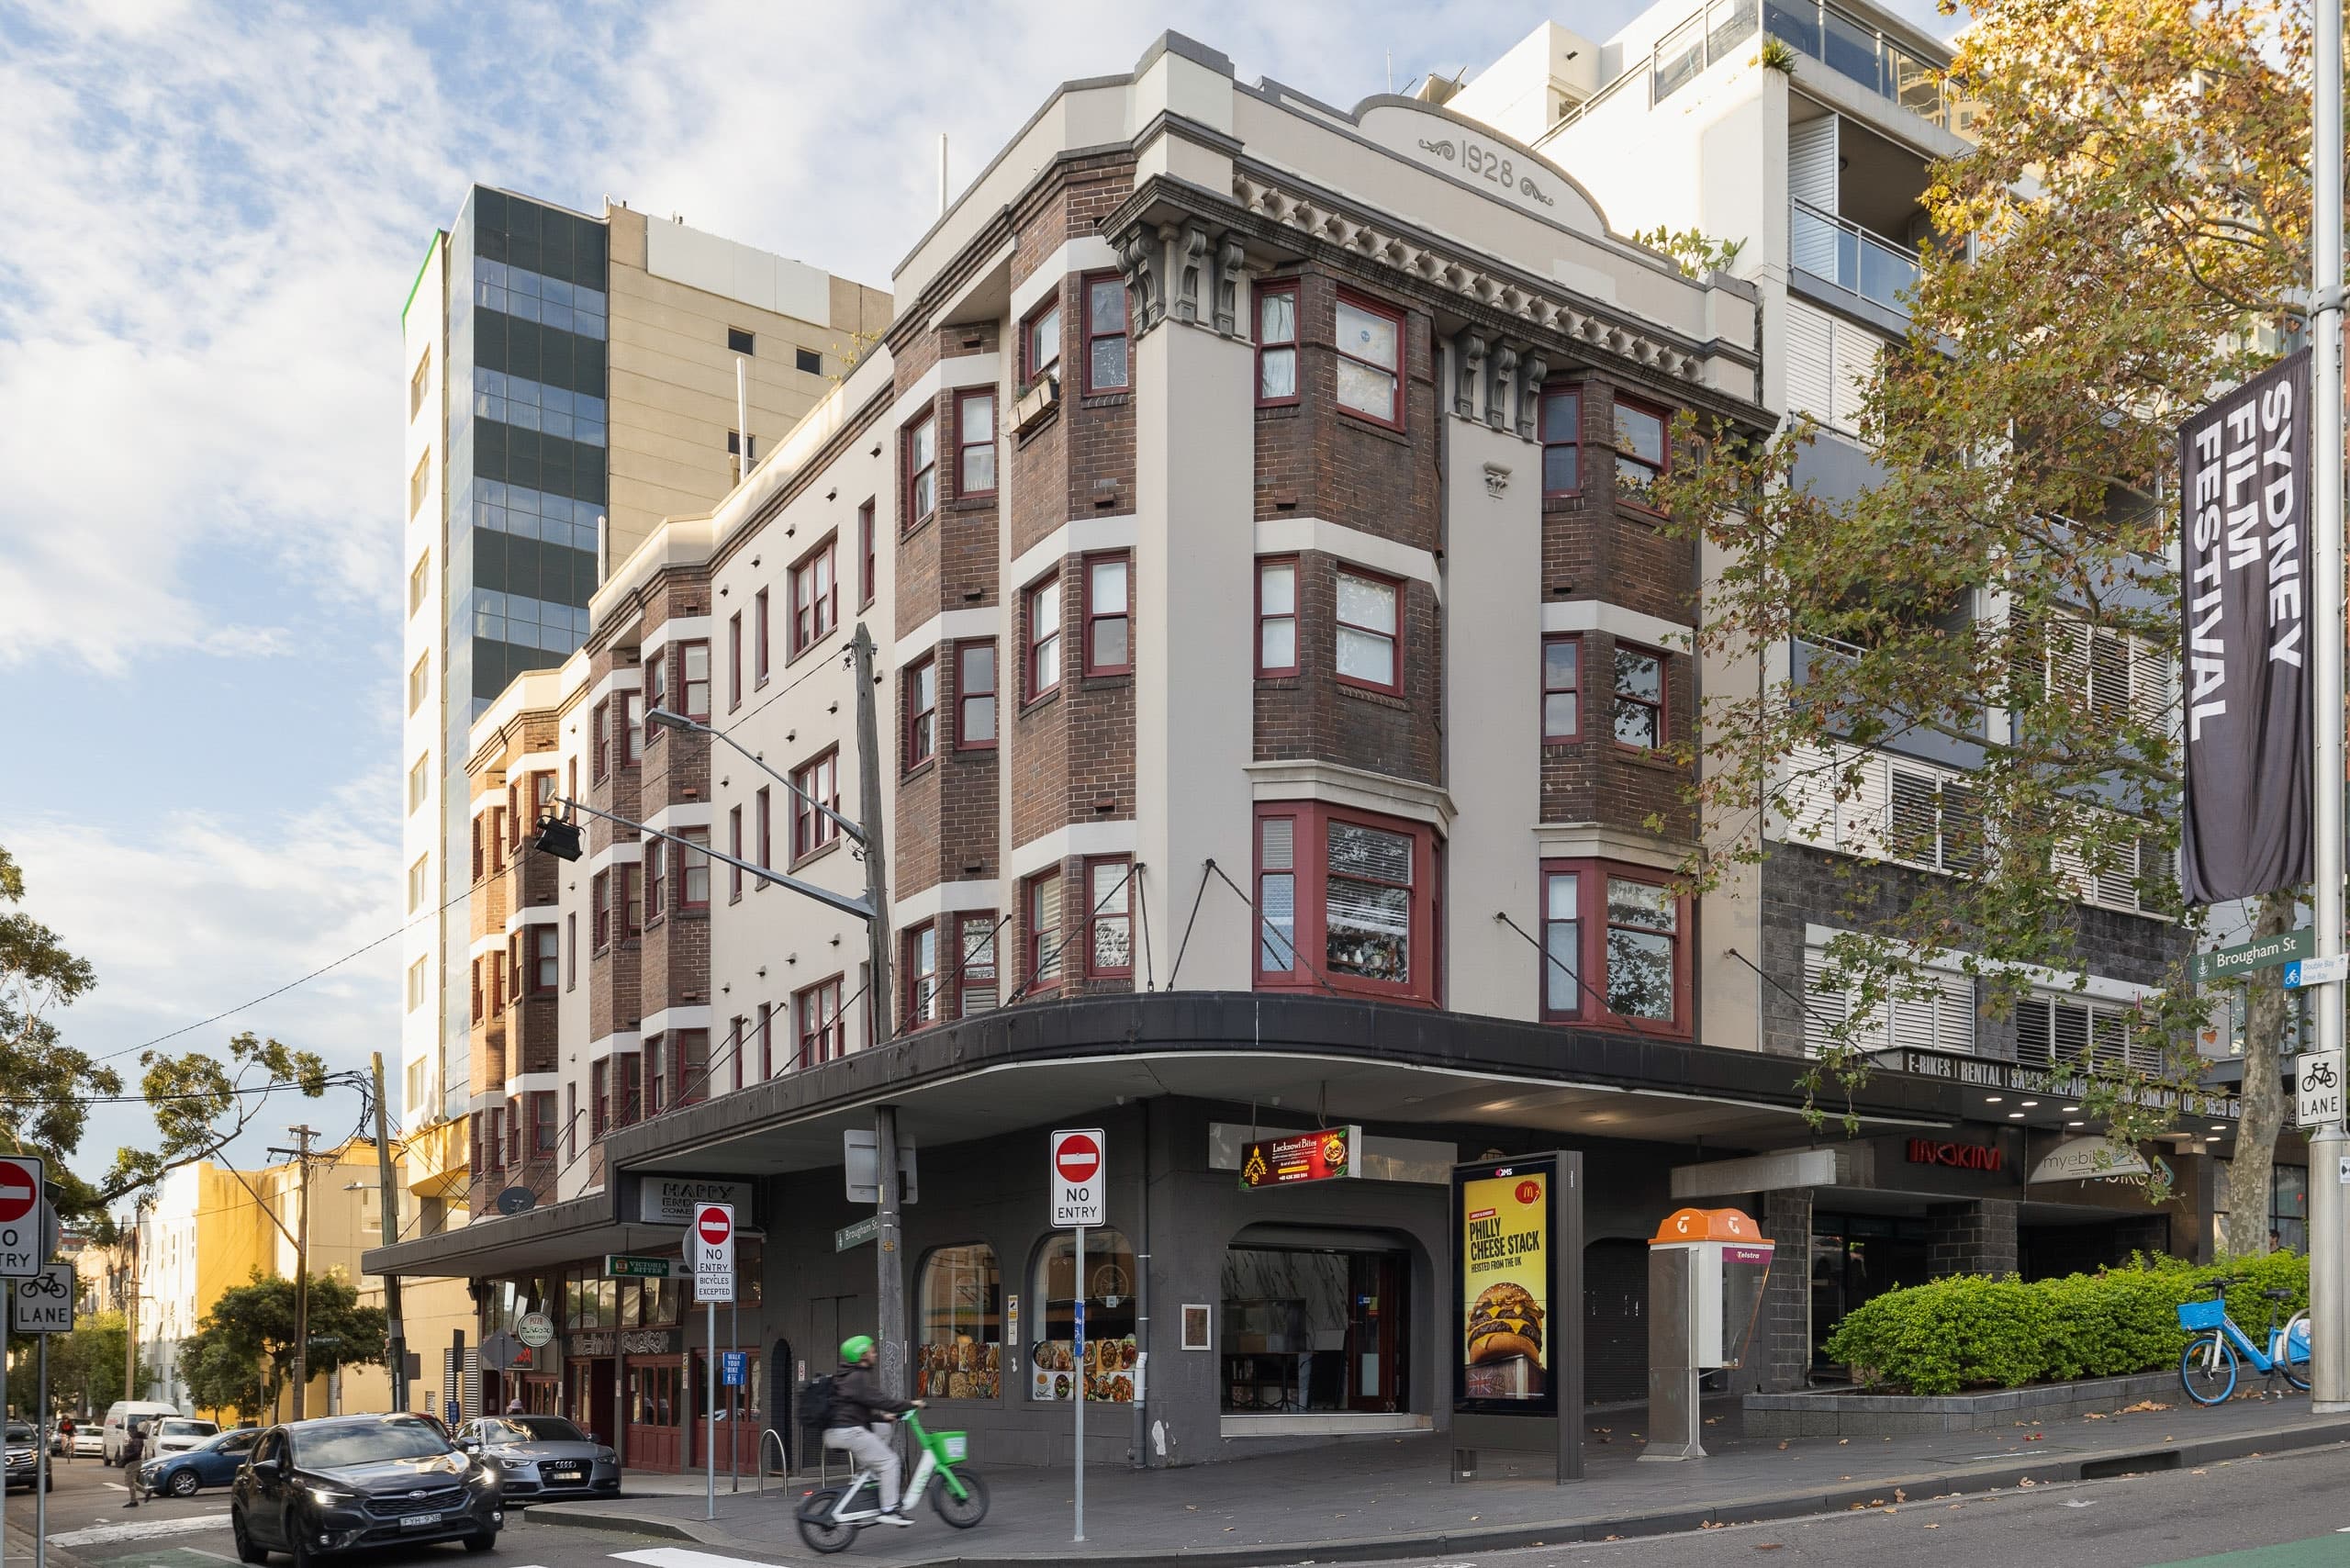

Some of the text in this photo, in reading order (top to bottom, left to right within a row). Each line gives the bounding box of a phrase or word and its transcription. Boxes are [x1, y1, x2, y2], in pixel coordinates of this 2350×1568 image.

[1461, 140, 1514, 188] 1928
[2225, 398, 2262, 571] FILM
[2262, 379, 2302, 669] SYDNEY
[2190, 419, 2227, 743] FESTIVAL
[2217, 936, 2297, 968] Brougham St
[1908, 1053, 1951, 1078] E-BIKES
[1961, 1062, 2002, 1087] RENTAL
[2301, 1096, 2338, 1116] LANE
[1302, 1137, 1317, 1148] Bites
[1909, 1137, 2001, 1171] INOKIM
[662, 1182, 735, 1199] HAPPY
[1066, 1188, 1090, 1202] NO
[1058, 1205, 1098, 1218] ENTRY
[2, 1228, 18, 1247] O
[845, 1224, 871, 1240] Brougham
[1469, 1217, 1501, 1241] PHILLY
[706, 1248, 722, 1260] NO
[1471, 1230, 1540, 1261] CHEESE STACK
[0, 1252, 30, 1267] TRY
[1737, 1251, 1760, 1260] Telstra
[629, 1260, 667, 1269] VICTORIA
[699, 1263, 728, 1271] ENTRY
[1471, 1256, 1522, 1273] HEISTED FROM THE UK
[20, 1307, 67, 1323] LANE
